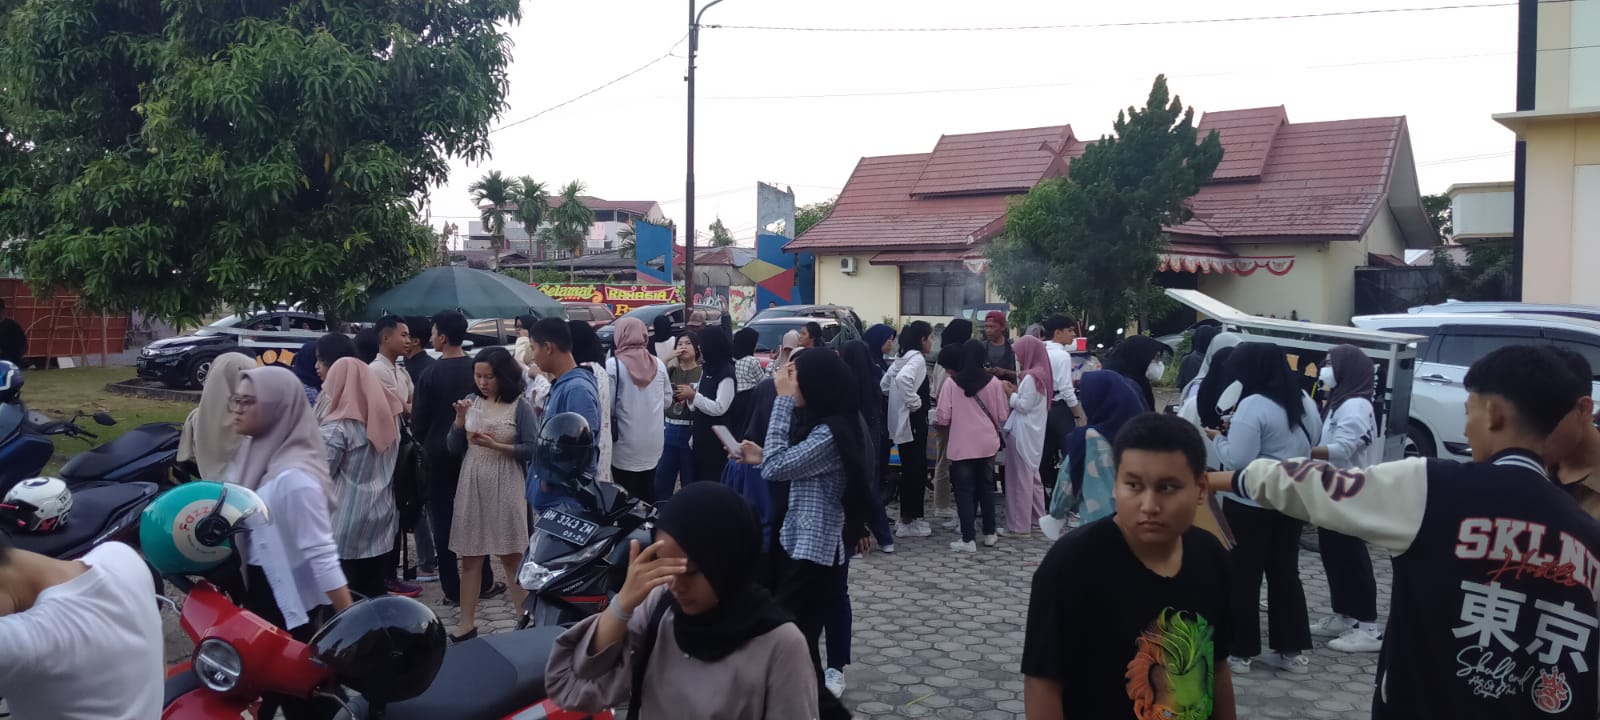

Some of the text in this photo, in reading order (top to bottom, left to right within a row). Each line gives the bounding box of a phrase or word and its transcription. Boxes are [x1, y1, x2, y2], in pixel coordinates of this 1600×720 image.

[539, 284, 596, 299] Selamat
[543, 510, 558, 521] BH
[557, 515, 580, 529] 3343
[1451, 580, 1599, 673] 東京
